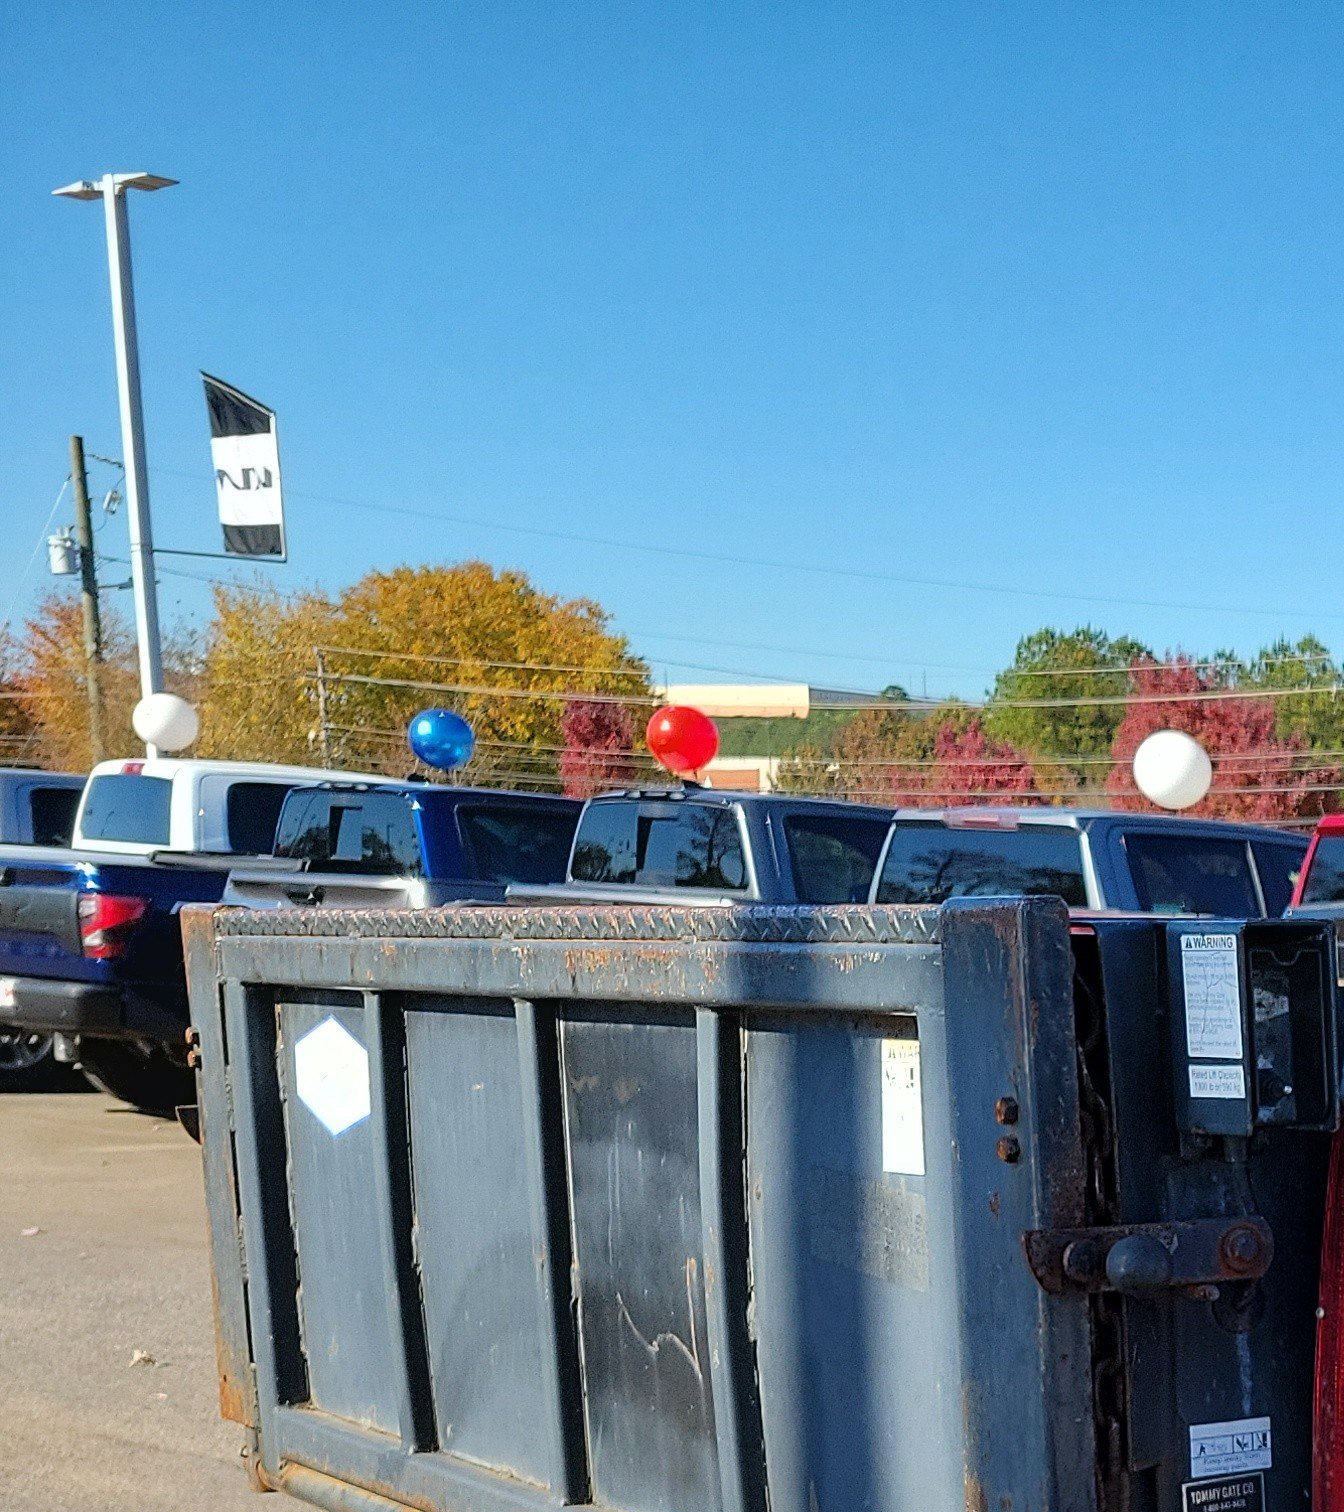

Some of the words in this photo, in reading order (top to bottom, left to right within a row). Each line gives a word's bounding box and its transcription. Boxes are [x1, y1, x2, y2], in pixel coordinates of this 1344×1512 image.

[1193, 937, 1233, 949] WARNING
[1190, 1488, 1220, 1504] TOMMY
[1221, 1484, 1241, 1498] GATE
